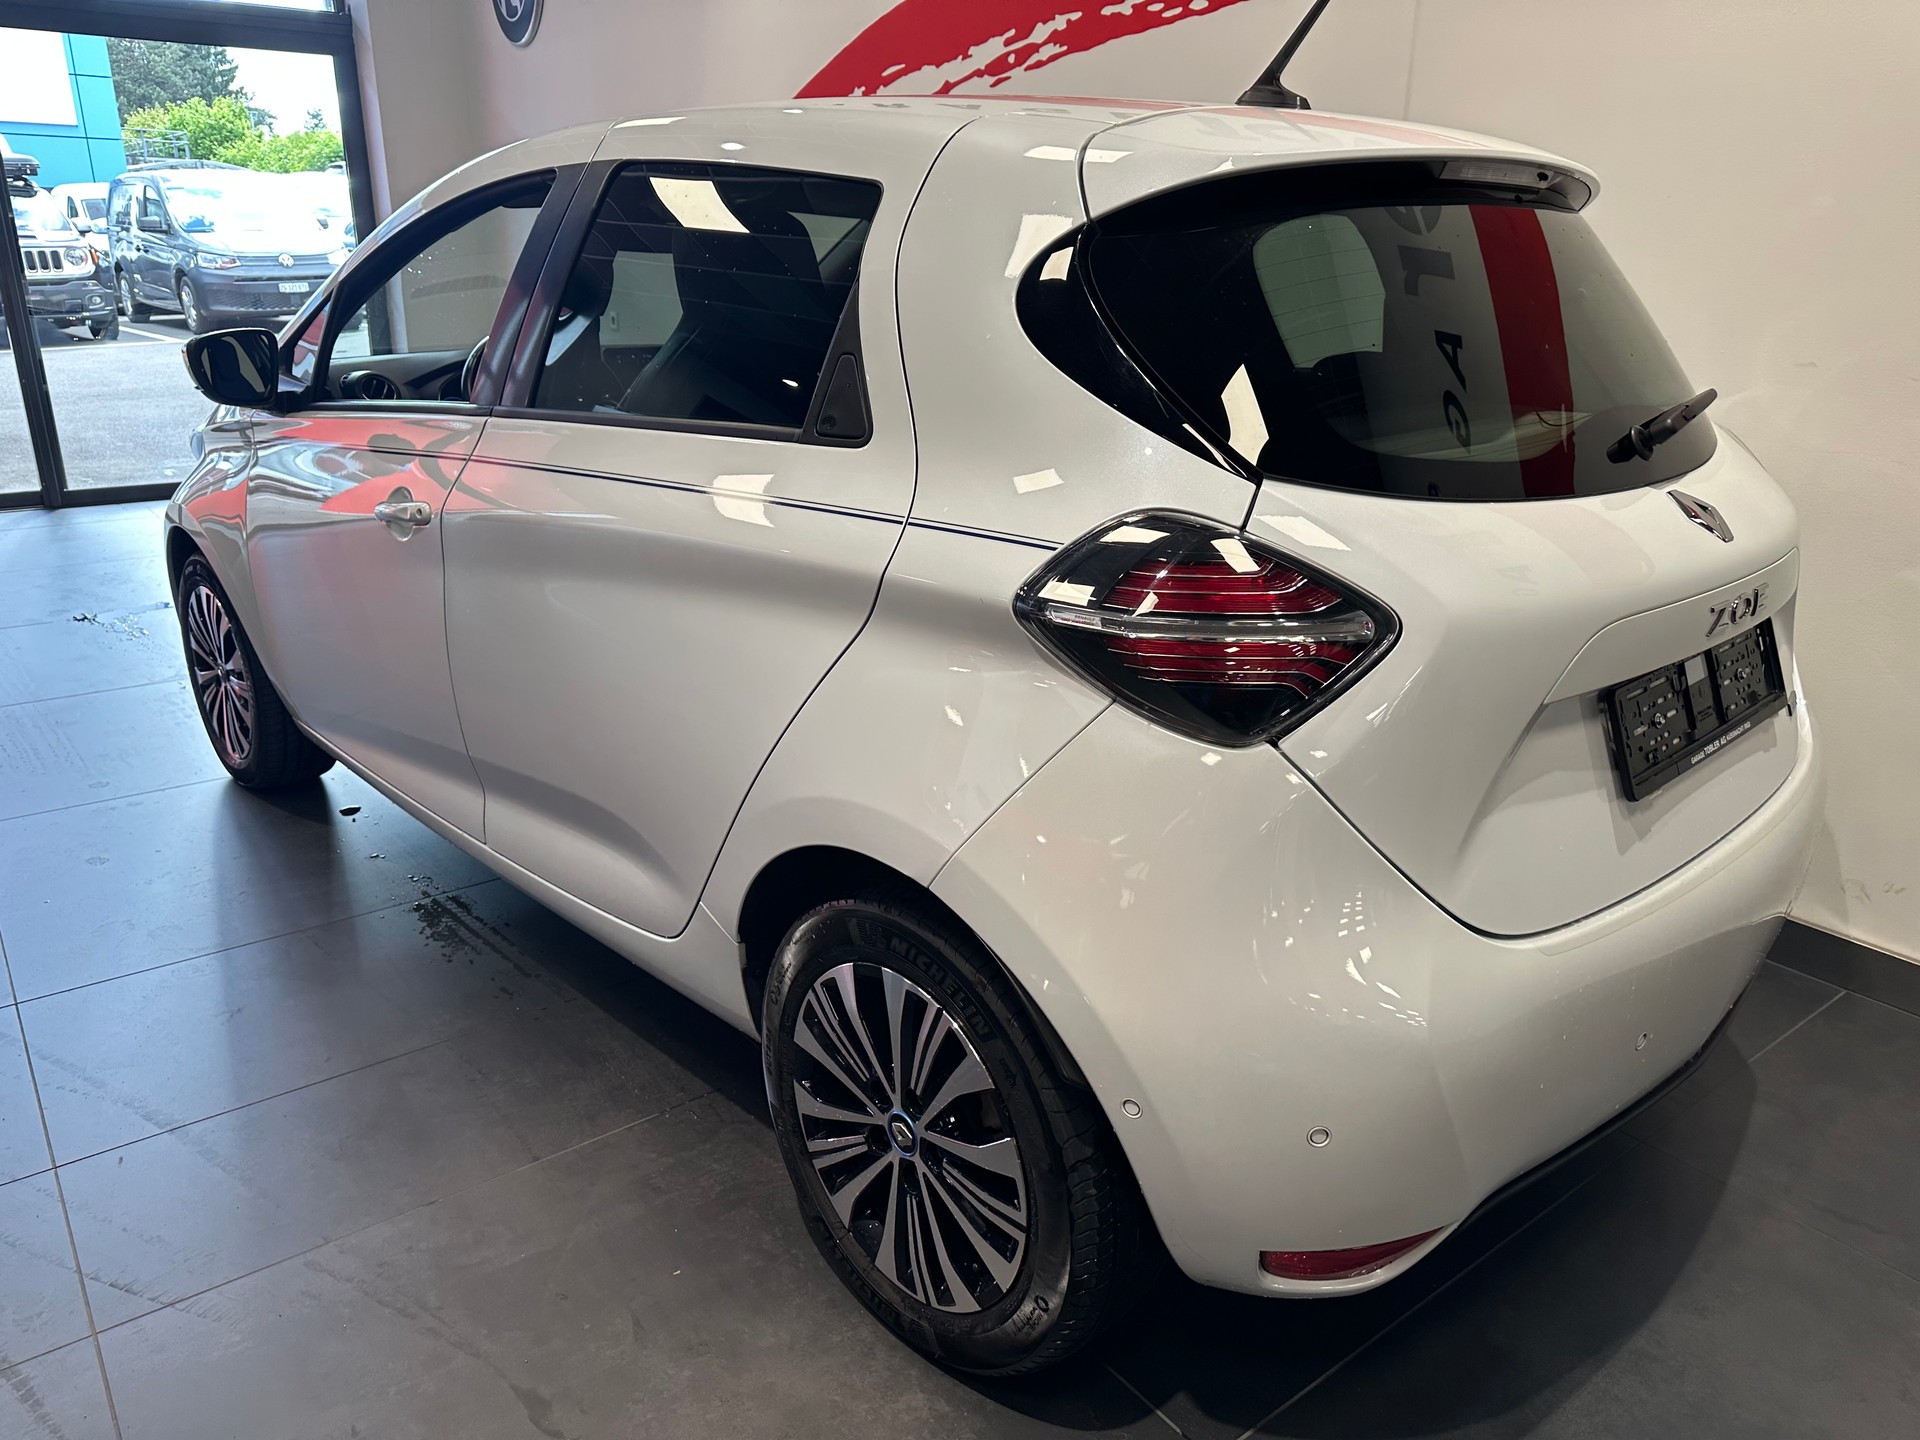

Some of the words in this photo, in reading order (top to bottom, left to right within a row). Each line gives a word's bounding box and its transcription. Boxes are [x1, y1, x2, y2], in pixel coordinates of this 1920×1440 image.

[1706, 582, 1769, 637] ZOE
[1690, 751, 1706, 764] GARAGE
[1704, 739, 1720, 755] TOBLER
[1720, 735, 1727, 746] AG
[887, 938, 991, 1038] MICHELIN
